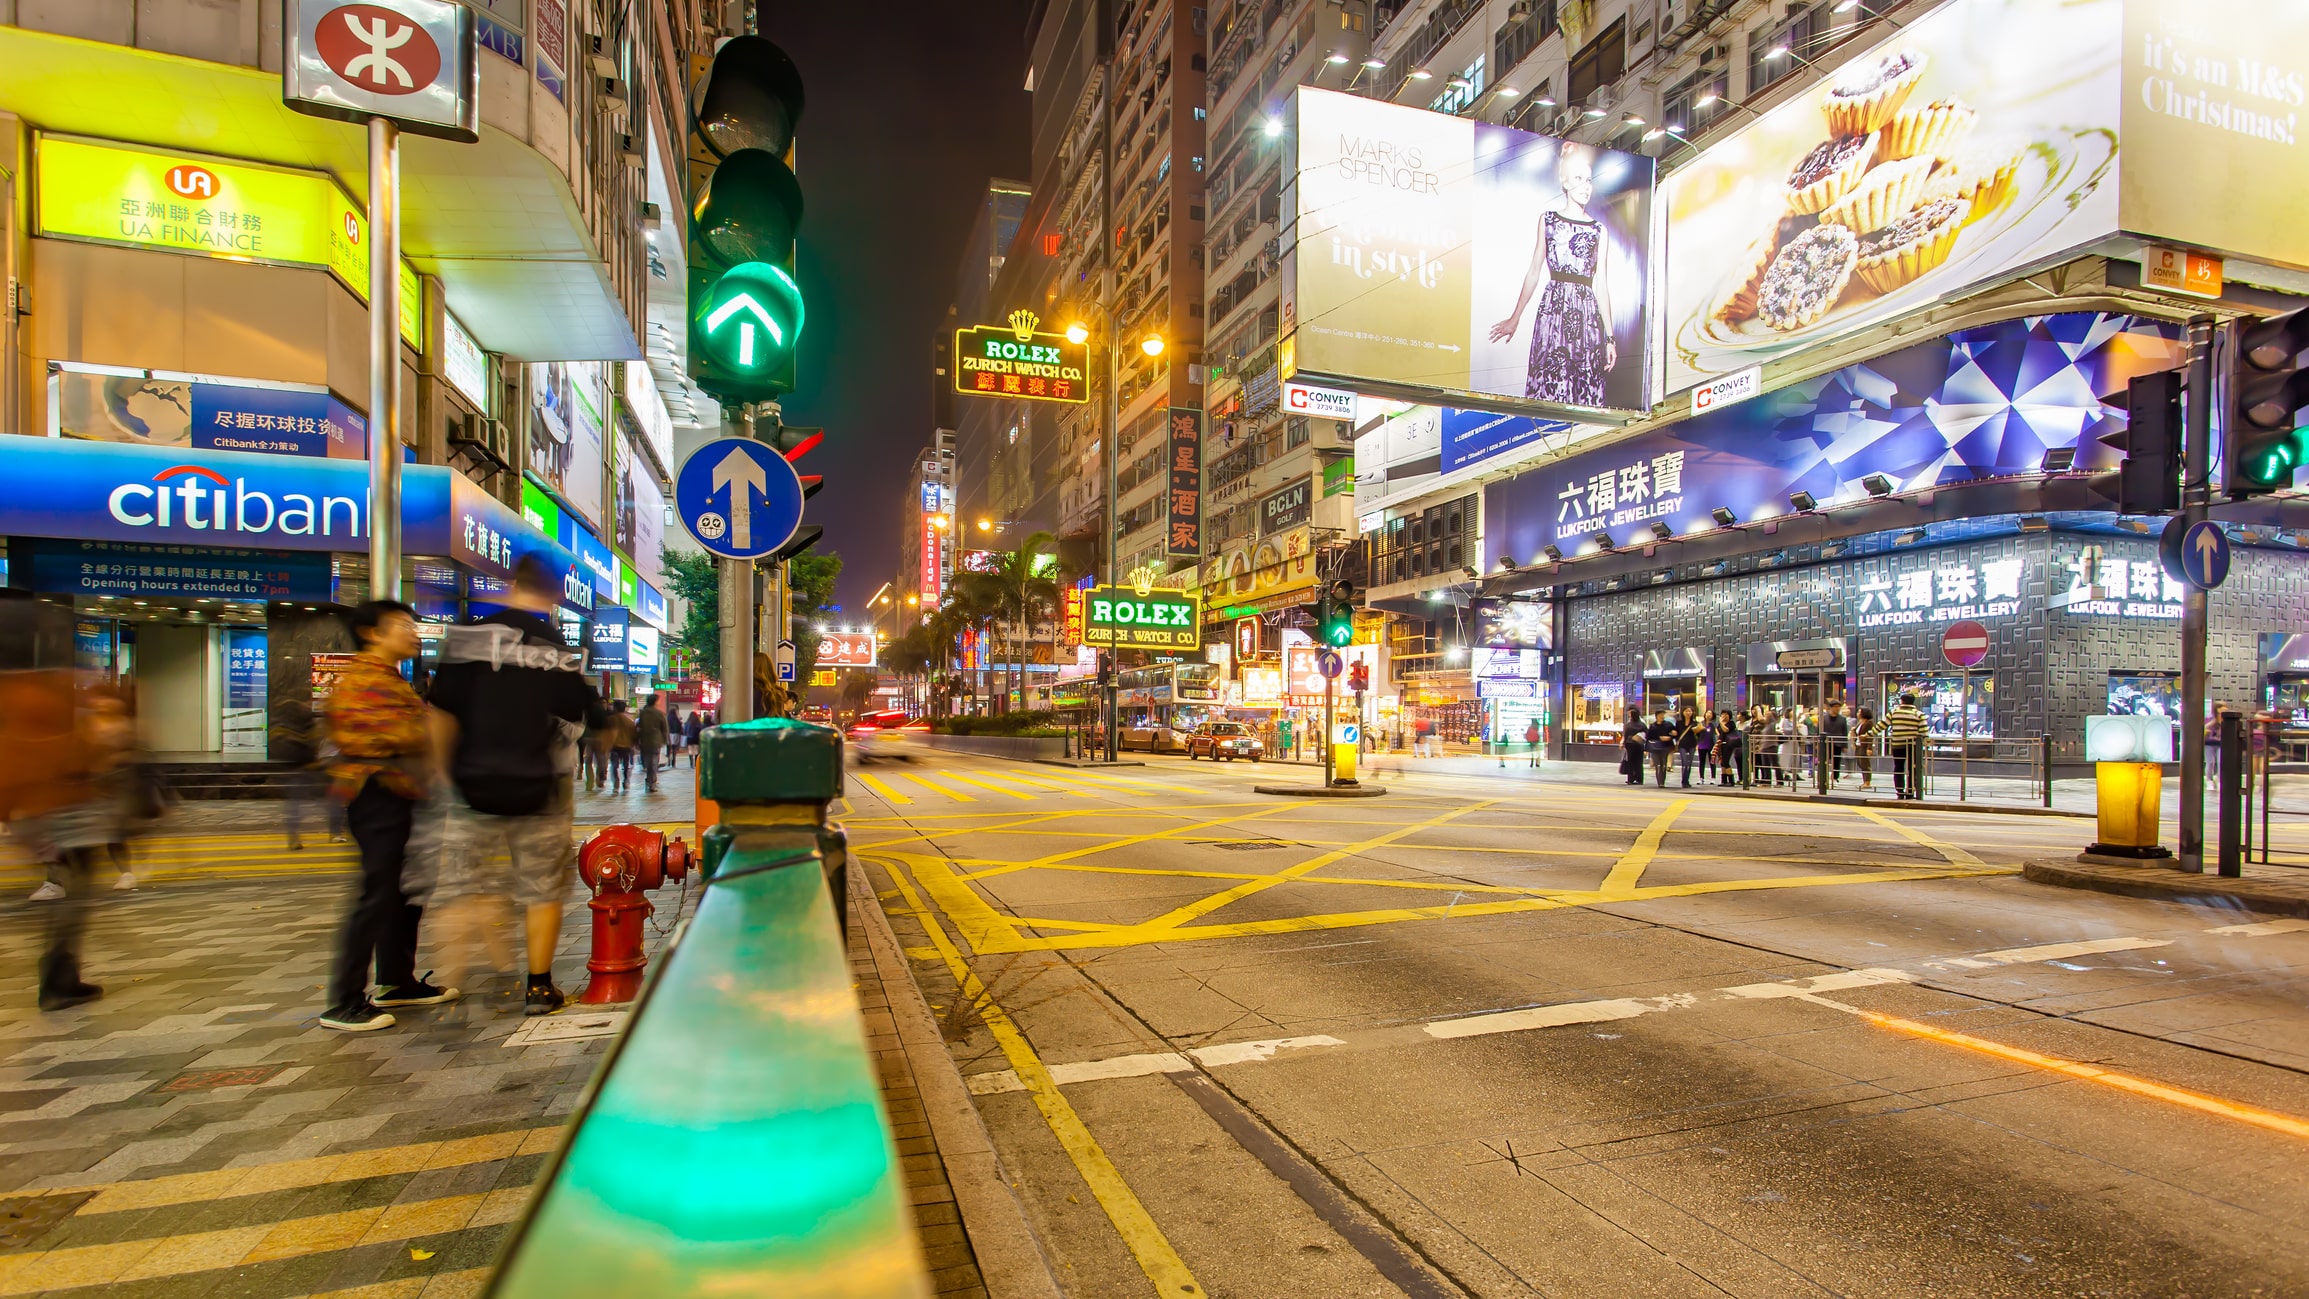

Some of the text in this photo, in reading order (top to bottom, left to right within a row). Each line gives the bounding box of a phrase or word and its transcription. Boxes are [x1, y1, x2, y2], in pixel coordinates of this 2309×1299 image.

[2143, 32, 2305, 107] it's an M&S
[2141, 75, 2297, 145] Christmas!
[1339, 133, 1422, 169] MARKS
[1339, 157, 1439, 195] SPENCER
[120, 198, 262, 232] 亞洲聯合財務
[120, 219, 262, 251] UA FINANCE
[1331, 236, 1444, 289] in style
[1311, 325, 1332, 335] Ocean
[1333, 328, 1354, 338] Centre
[986, 341, 1060, 364] ROLEX
[963, 357, 1082, 380] ZURICH WATCH CO.
[1713, 374, 1751, 395] CONVEY
[1309, 391, 1351, 406] CONVEY
[1317, 403, 1351, 414] 2739 3806
[1558, 450, 1685, 523] 六福珠寶
[108, 476, 371, 537] citiban
[1276, 512, 1294, 525] GOLF
[1557, 496, 1684, 539] LUKFOOK JEWELLERY
[463, 514, 511, 570] 花旗銀行
[81, 577, 290, 595] Opening hours extended to 7pm
[565, 567, 593, 611] citibank
[1859, 559, 2024, 613] 六福珠寶
[1094, 601, 1190, 626] ROLEX
[1481, 607, 1517, 618] OMEGA
[1858, 601, 2022, 627] LUKFOOK JEWELLERY
[593, 623, 624, 637] 六福
[1134, 630, 1172, 643] WATCH
[1177, 633, 1195, 644] CO.
[778, 664, 791, 678] P
